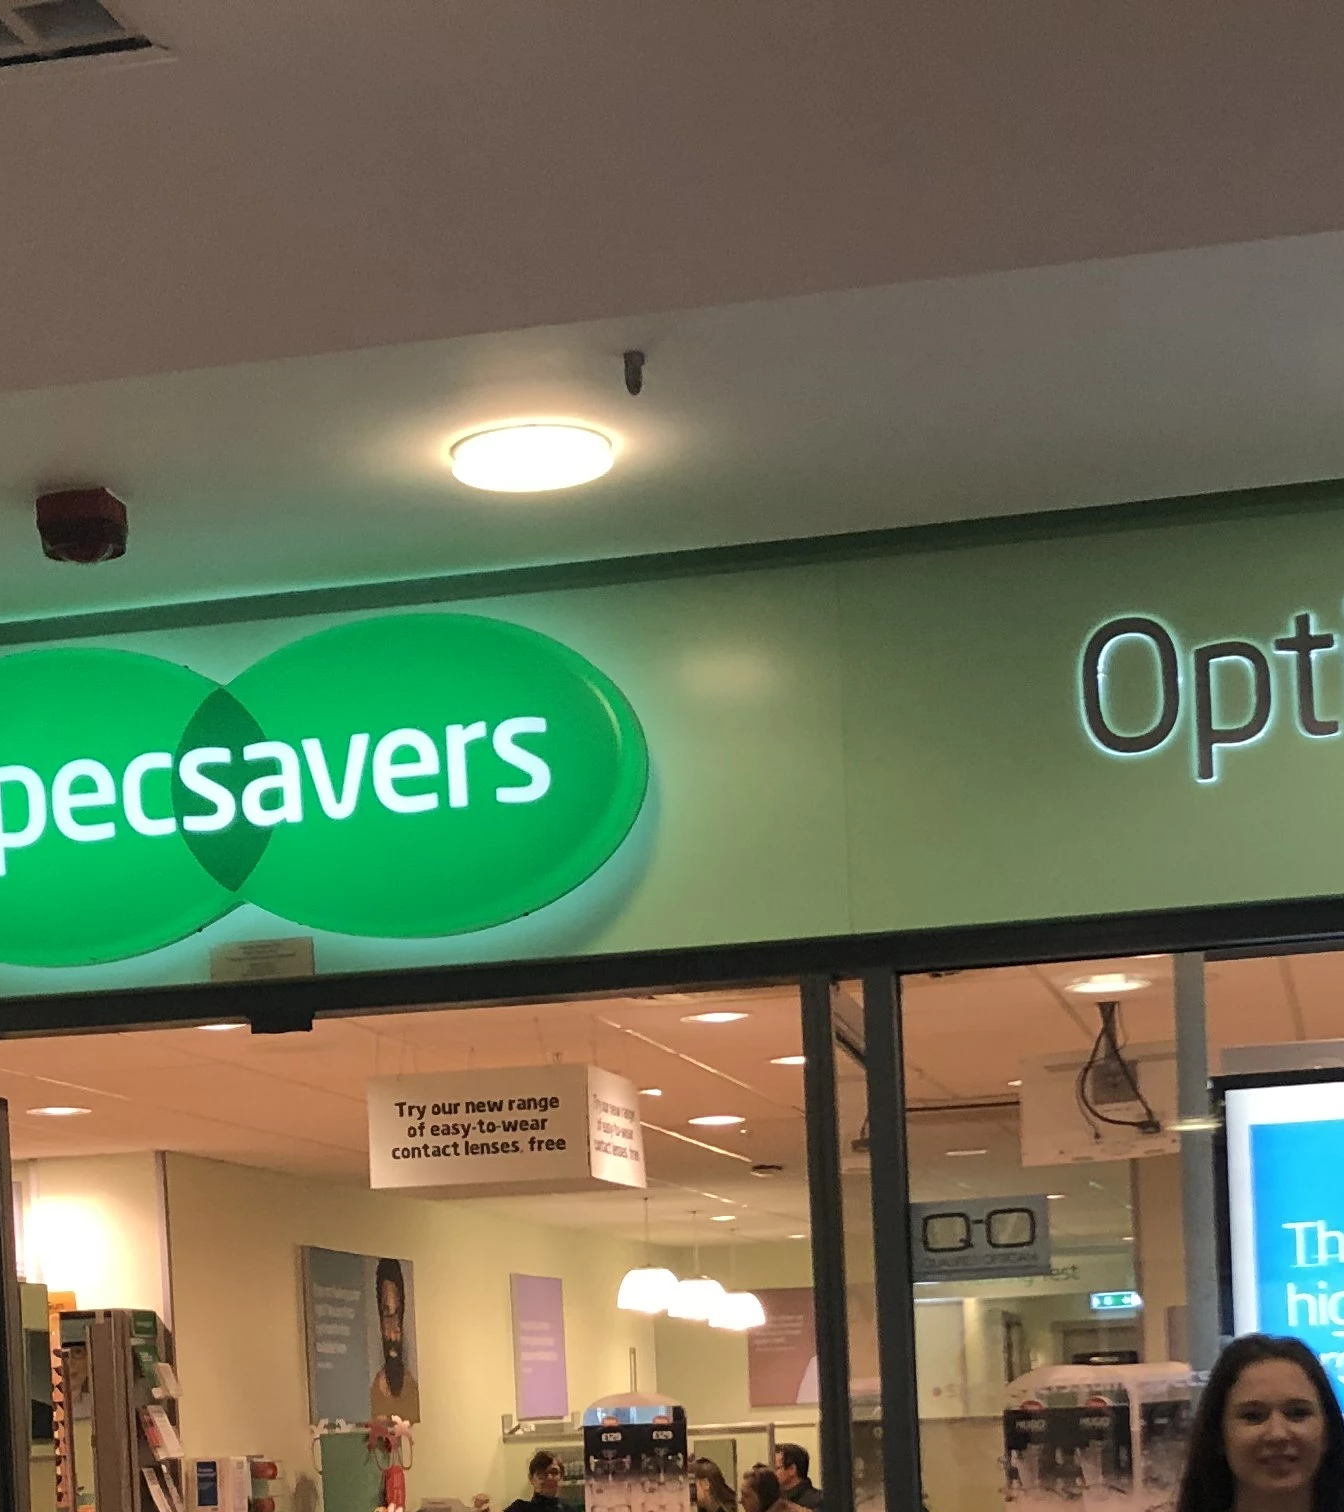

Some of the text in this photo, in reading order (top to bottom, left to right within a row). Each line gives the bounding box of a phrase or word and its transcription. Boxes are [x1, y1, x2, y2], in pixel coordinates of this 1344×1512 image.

[394, 1095, 560, 1120] Try our new range
[407, 1117, 548, 1138] of easy-to-wear
[391, 1143, 460, 1160] contact
[528, 1136, 566, 1152] free
